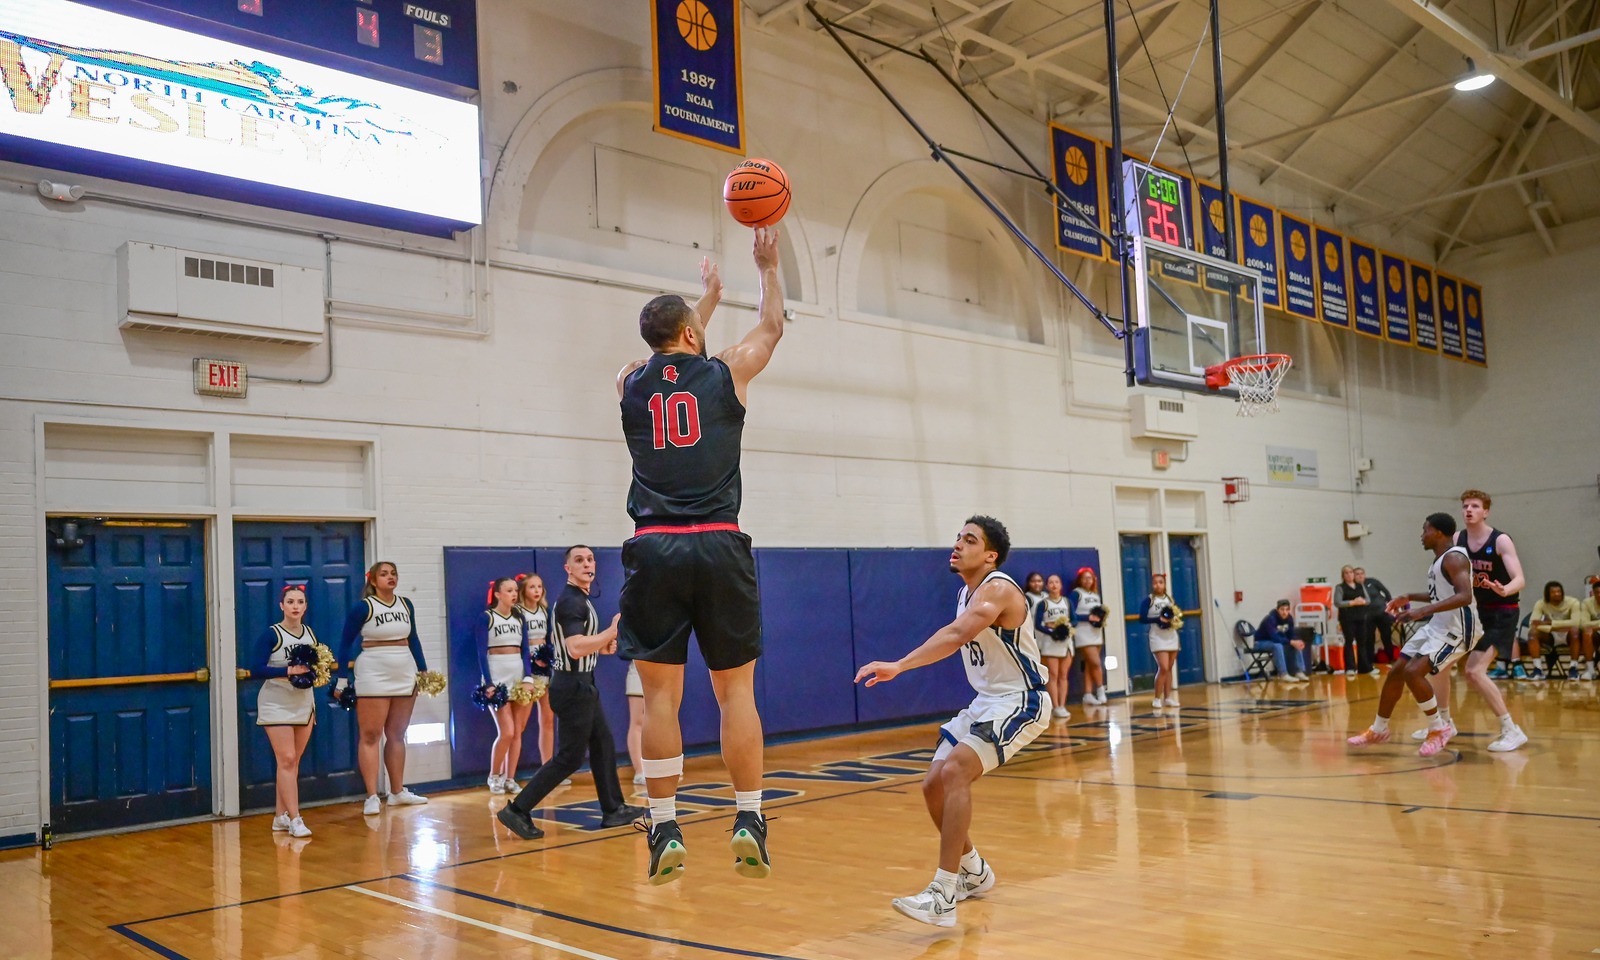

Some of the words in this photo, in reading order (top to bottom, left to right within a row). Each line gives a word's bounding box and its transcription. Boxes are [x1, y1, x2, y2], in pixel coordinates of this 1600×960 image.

[405, 5, 448, 26] FOULS
[681, 69, 716, 90] 1987
[74, 65, 202, 103] NORTH
[221, 98, 381, 146] CAROLINA
[685, 92, 714, 110] NCAA
[664, 104, 735, 134] TOURNAMENT
[731, 181, 756, 191] EVO
[1148, 174, 1178, 206] 6:00
[1146, 198, 1179, 247] 26
[209, 363, 240, 388] EXIT
[648, 391, 702, 450] 10
[375, 611, 410, 627] NCWU
